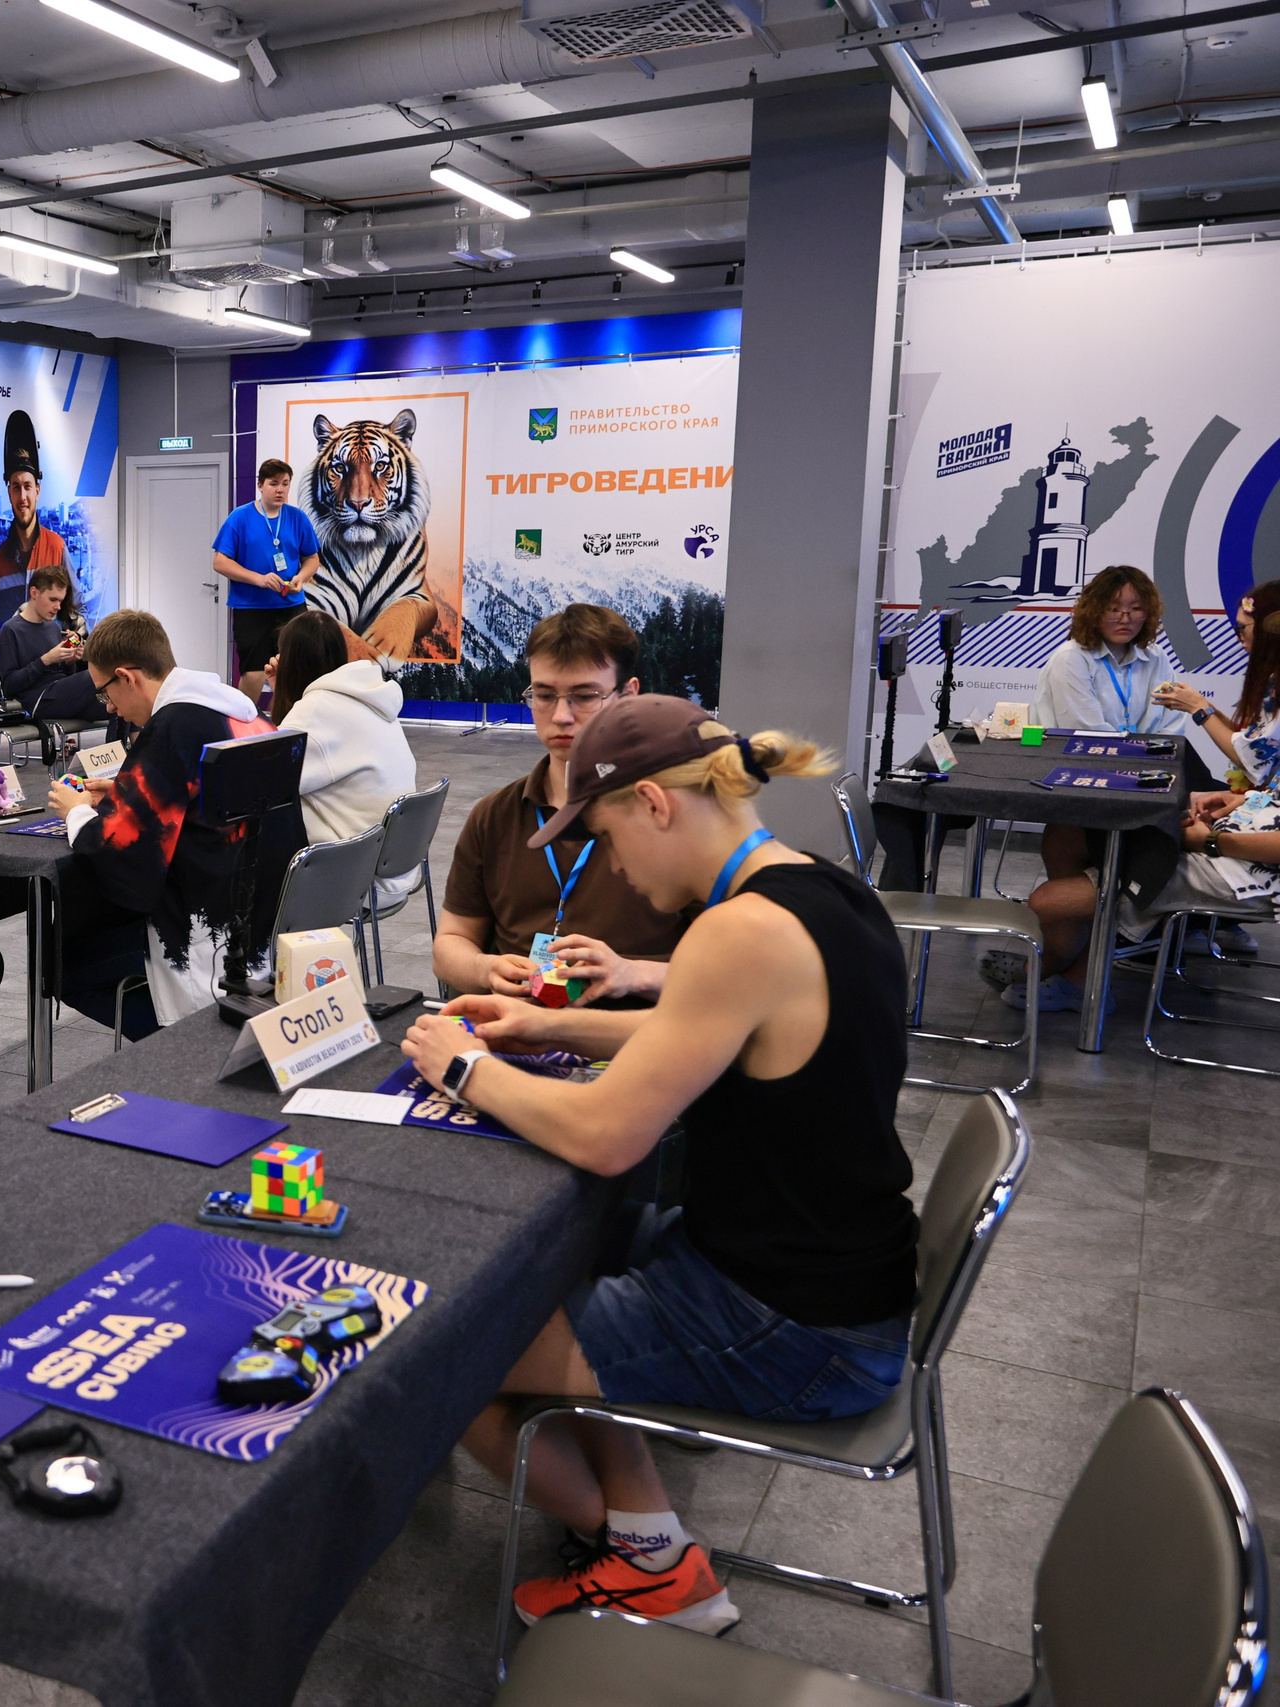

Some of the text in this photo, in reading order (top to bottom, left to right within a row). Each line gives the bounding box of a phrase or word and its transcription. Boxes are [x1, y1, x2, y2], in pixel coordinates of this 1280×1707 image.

[569, 403, 691, 421] ПРАВИТЕЛЬСТВО
[569, 416, 719, 435] ПРИМОРСКОГО КРАЯ
[162, 439, 189, 449] ВЫХОД
[937, 452, 1010, 477] ПРИМОРСКИЙ КРАЙ
[615, 532, 642, 541] ЦЕНТР
[690, 524, 720, 543] УРСА
[615, 538, 660, 548] АМУРСКИЙ
[615, 548, 636, 556] ТИГР
[936, 680, 964, 688] ШАБ
[90, 749, 119, 767] Стол 1
[280, 996, 345, 1044] Стол 5
[335, 1038, 352, 1053] PARTY
[26, 1314, 156, 1389] SEA
[76, 1322, 188, 1401] CUBING
